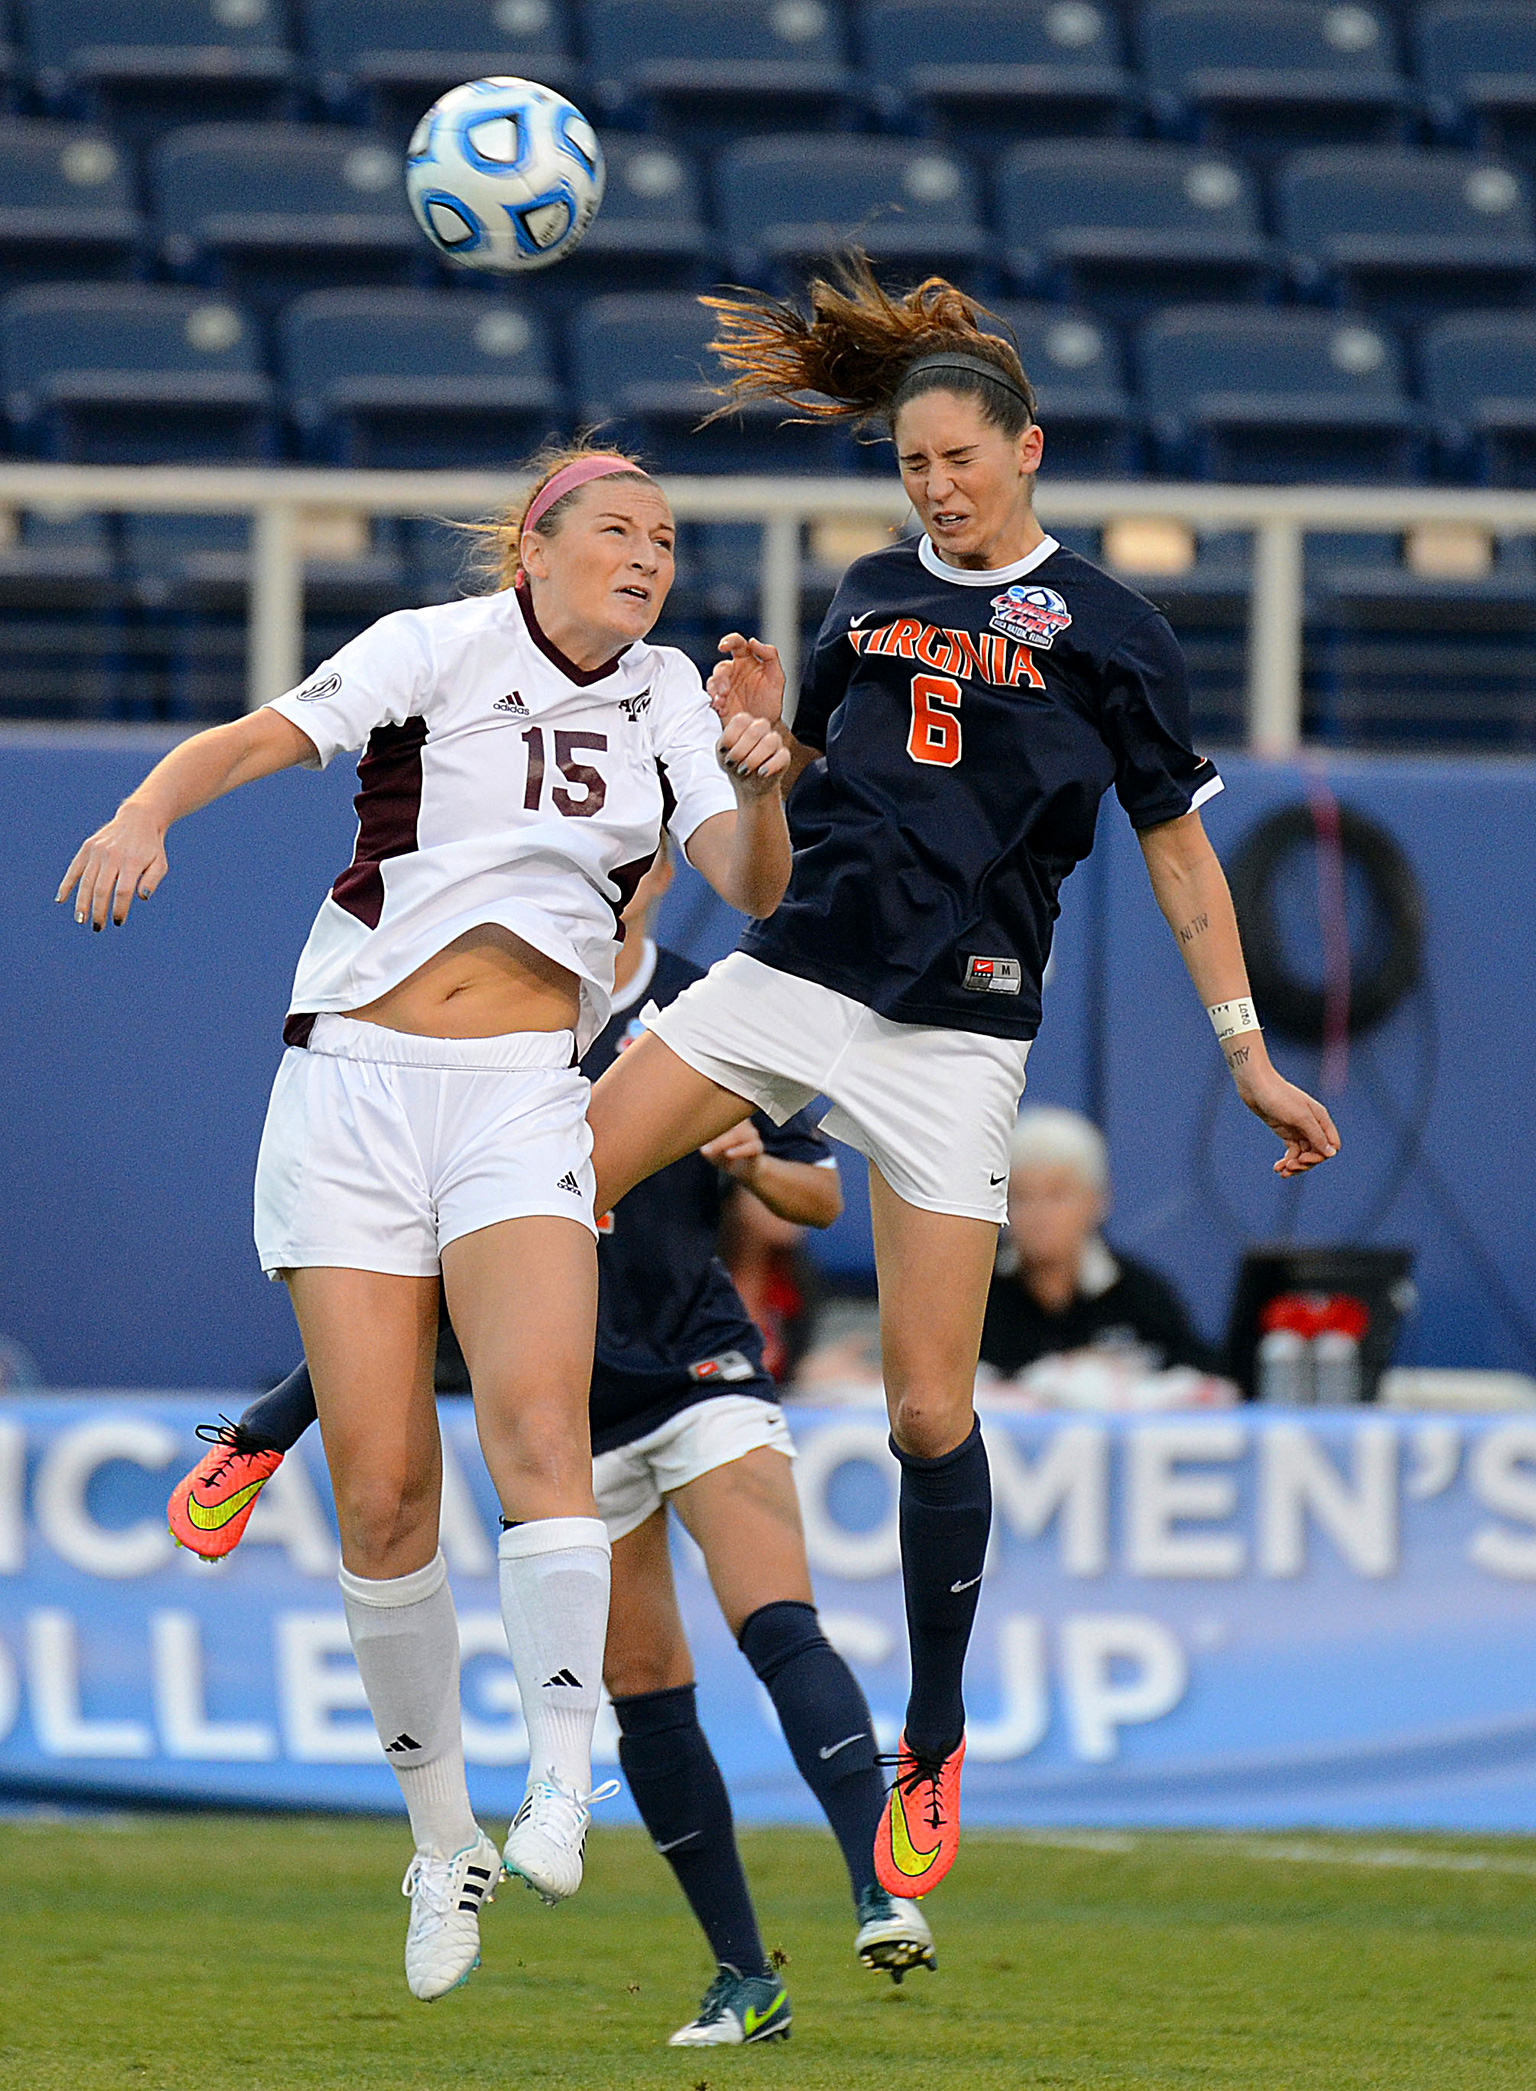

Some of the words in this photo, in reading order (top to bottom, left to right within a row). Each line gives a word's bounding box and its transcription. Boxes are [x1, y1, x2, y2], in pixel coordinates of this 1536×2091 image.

[993, 597, 1070, 627] College
[1004, 611, 1047, 634] Cup
[848, 618, 1046, 690] VIRGINIA
[492, 703, 530, 716] adidas
[906, 673, 962, 768] 6
[521, 726, 608, 817] 15
[1001, 964, 1011, 976] M
